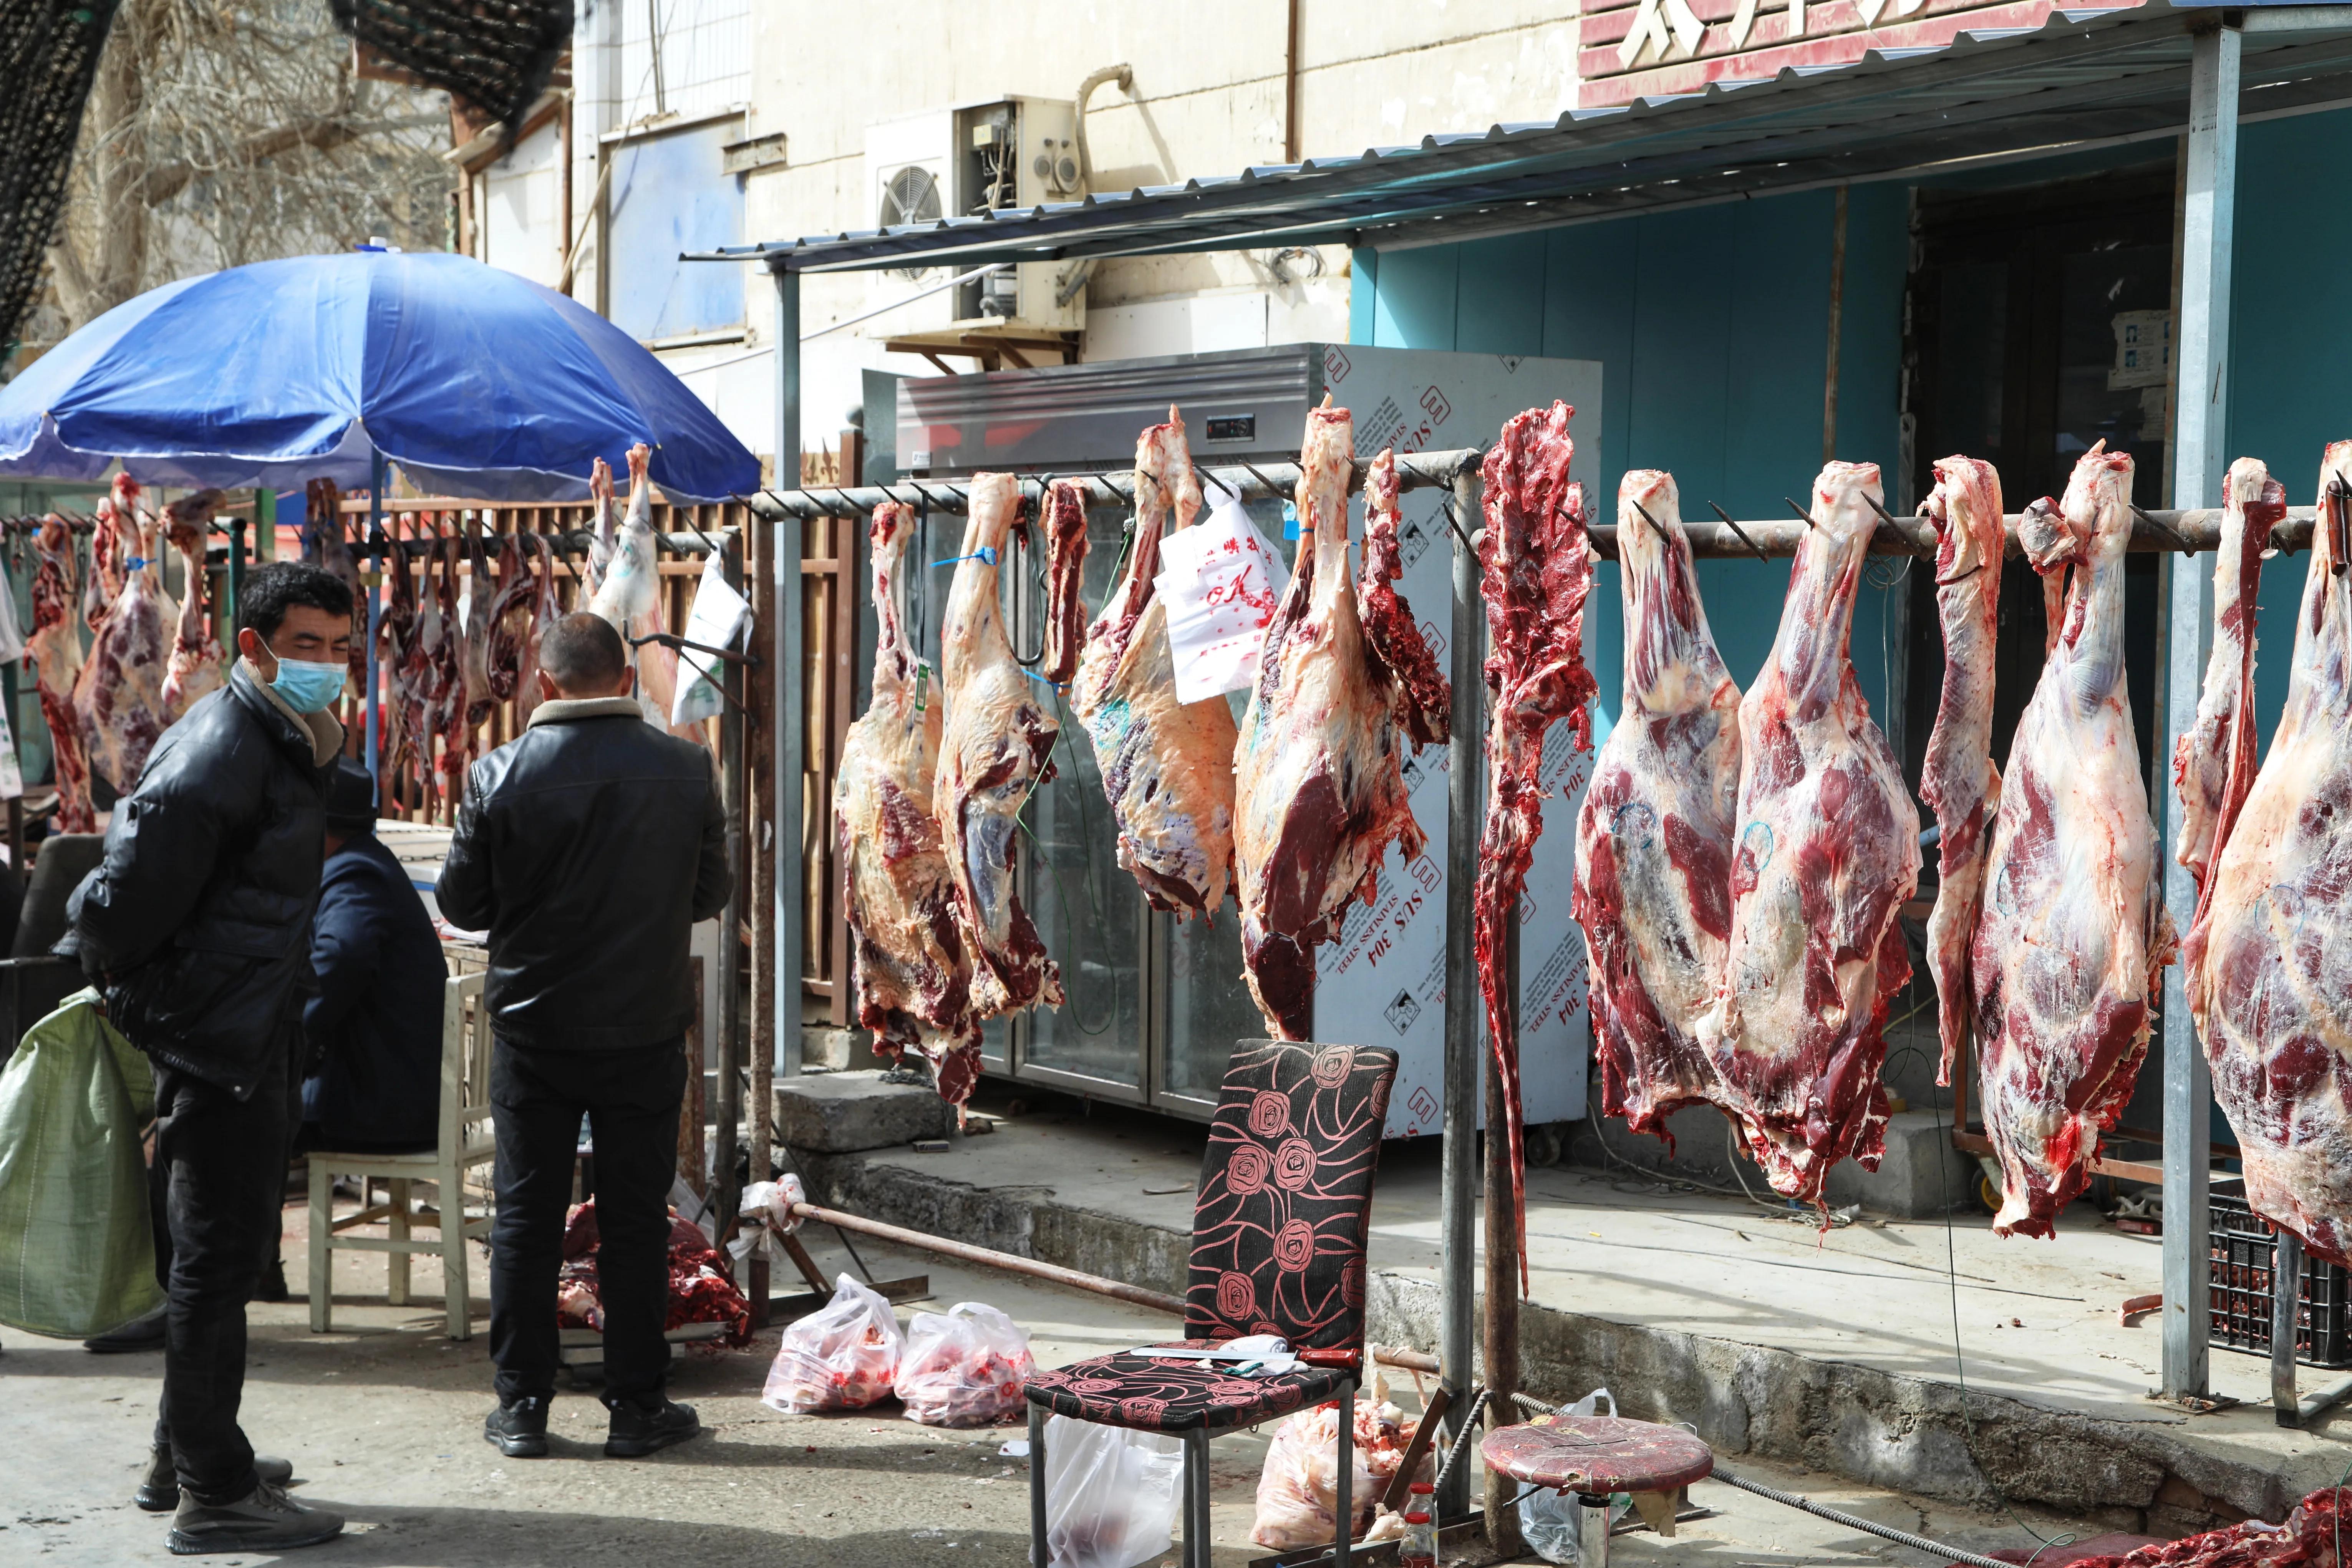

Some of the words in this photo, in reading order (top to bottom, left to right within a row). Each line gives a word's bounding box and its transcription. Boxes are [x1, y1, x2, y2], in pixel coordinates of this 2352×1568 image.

[1378, 422, 1407, 459] STAIN
[1554, 747, 1580, 779] INLESS
[1560, 764, 1589, 802] 304
[1359, 893, 1399, 946] STAINLESS
[1391, 888, 1425, 932] SUS
[1335, 943, 1361, 977] STEEL
[1364, 929, 1395, 968] 304
[1549, 954, 1588, 1005] STAINLESS
[1527, 1003, 1552, 1036] STEEL
[1555, 988, 1584, 1026] 304
